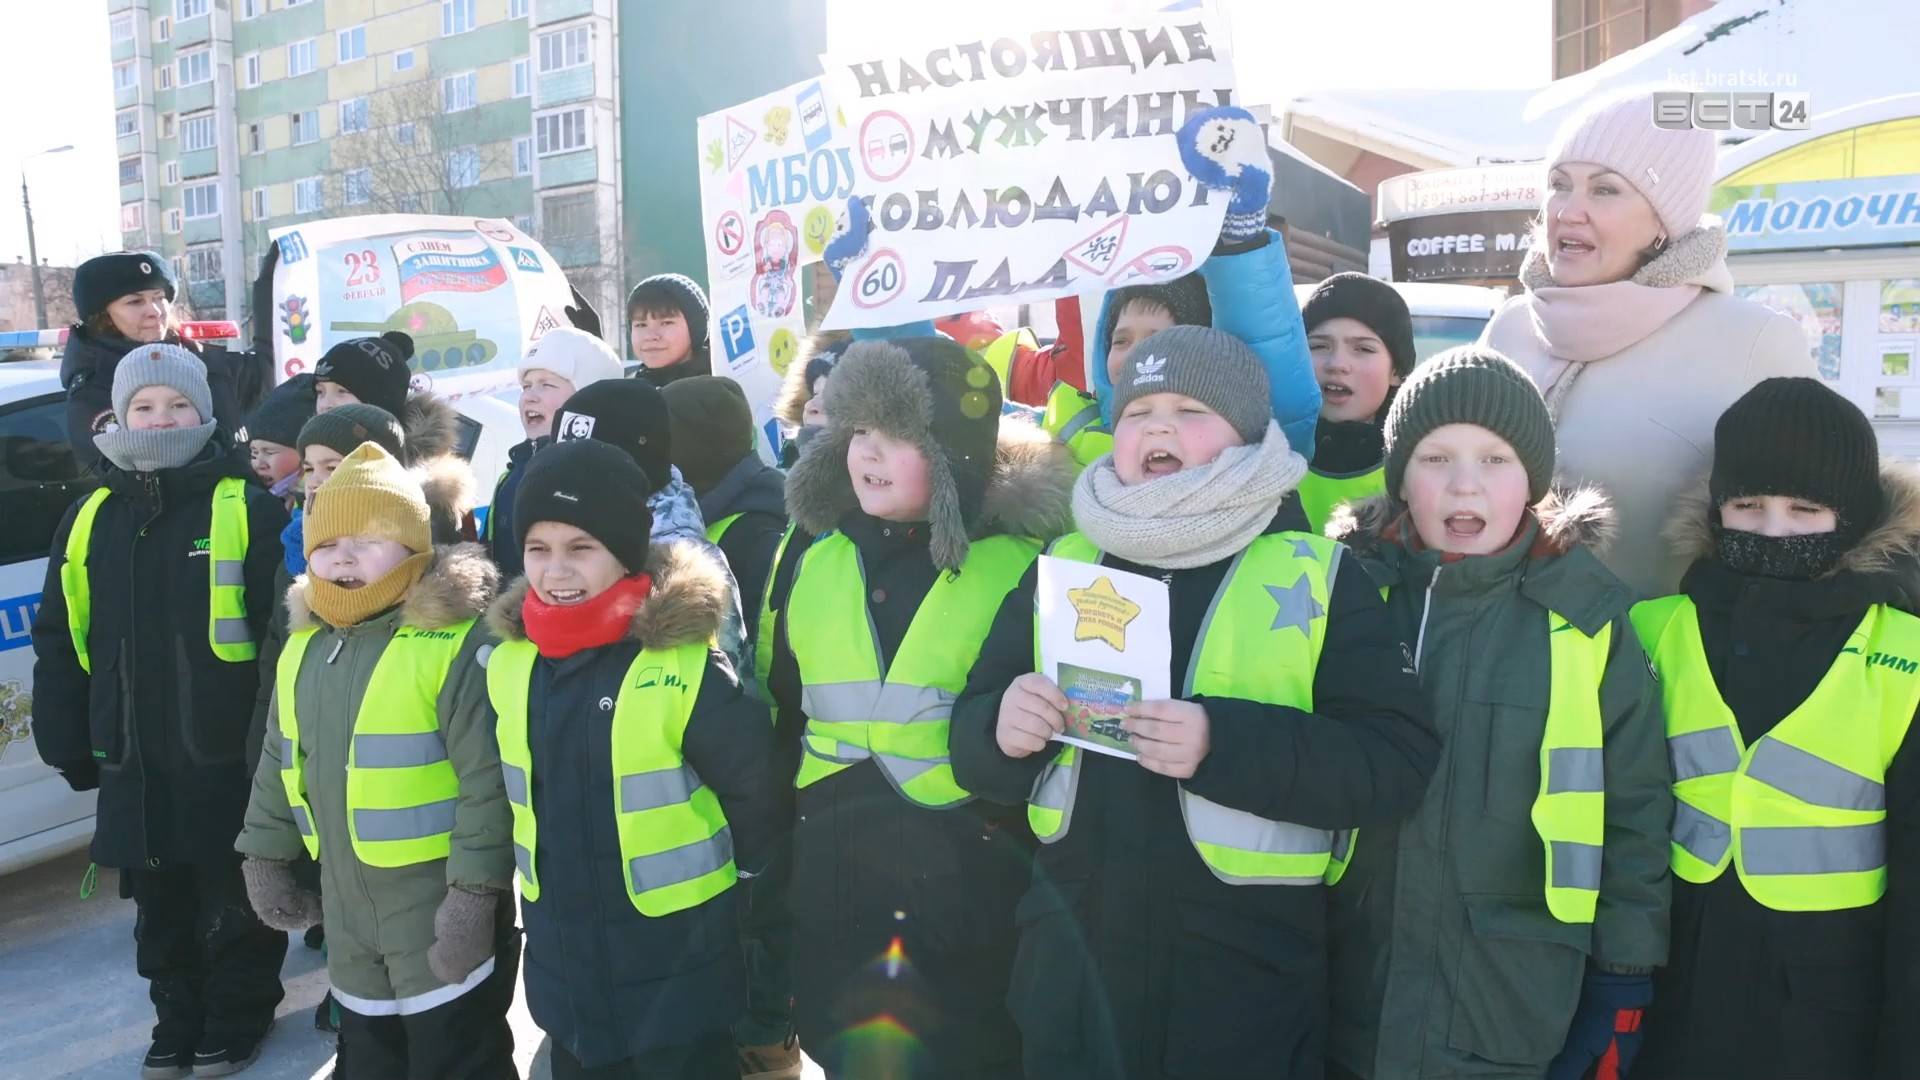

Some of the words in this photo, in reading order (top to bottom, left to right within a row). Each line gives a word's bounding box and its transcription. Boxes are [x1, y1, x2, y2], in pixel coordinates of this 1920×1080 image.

[848, 21, 1216, 98] НАСТОЯЩИЕ
[747, 147, 855, 214] МБОУ
[1407, 234, 1485, 256] COFFEE
[344, 249, 382, 287] 23
[862, 262, 898, 296] 60
[1133, 373, 1164, 386] adidas
[414, 631, 456, 640] ИЛИМ
